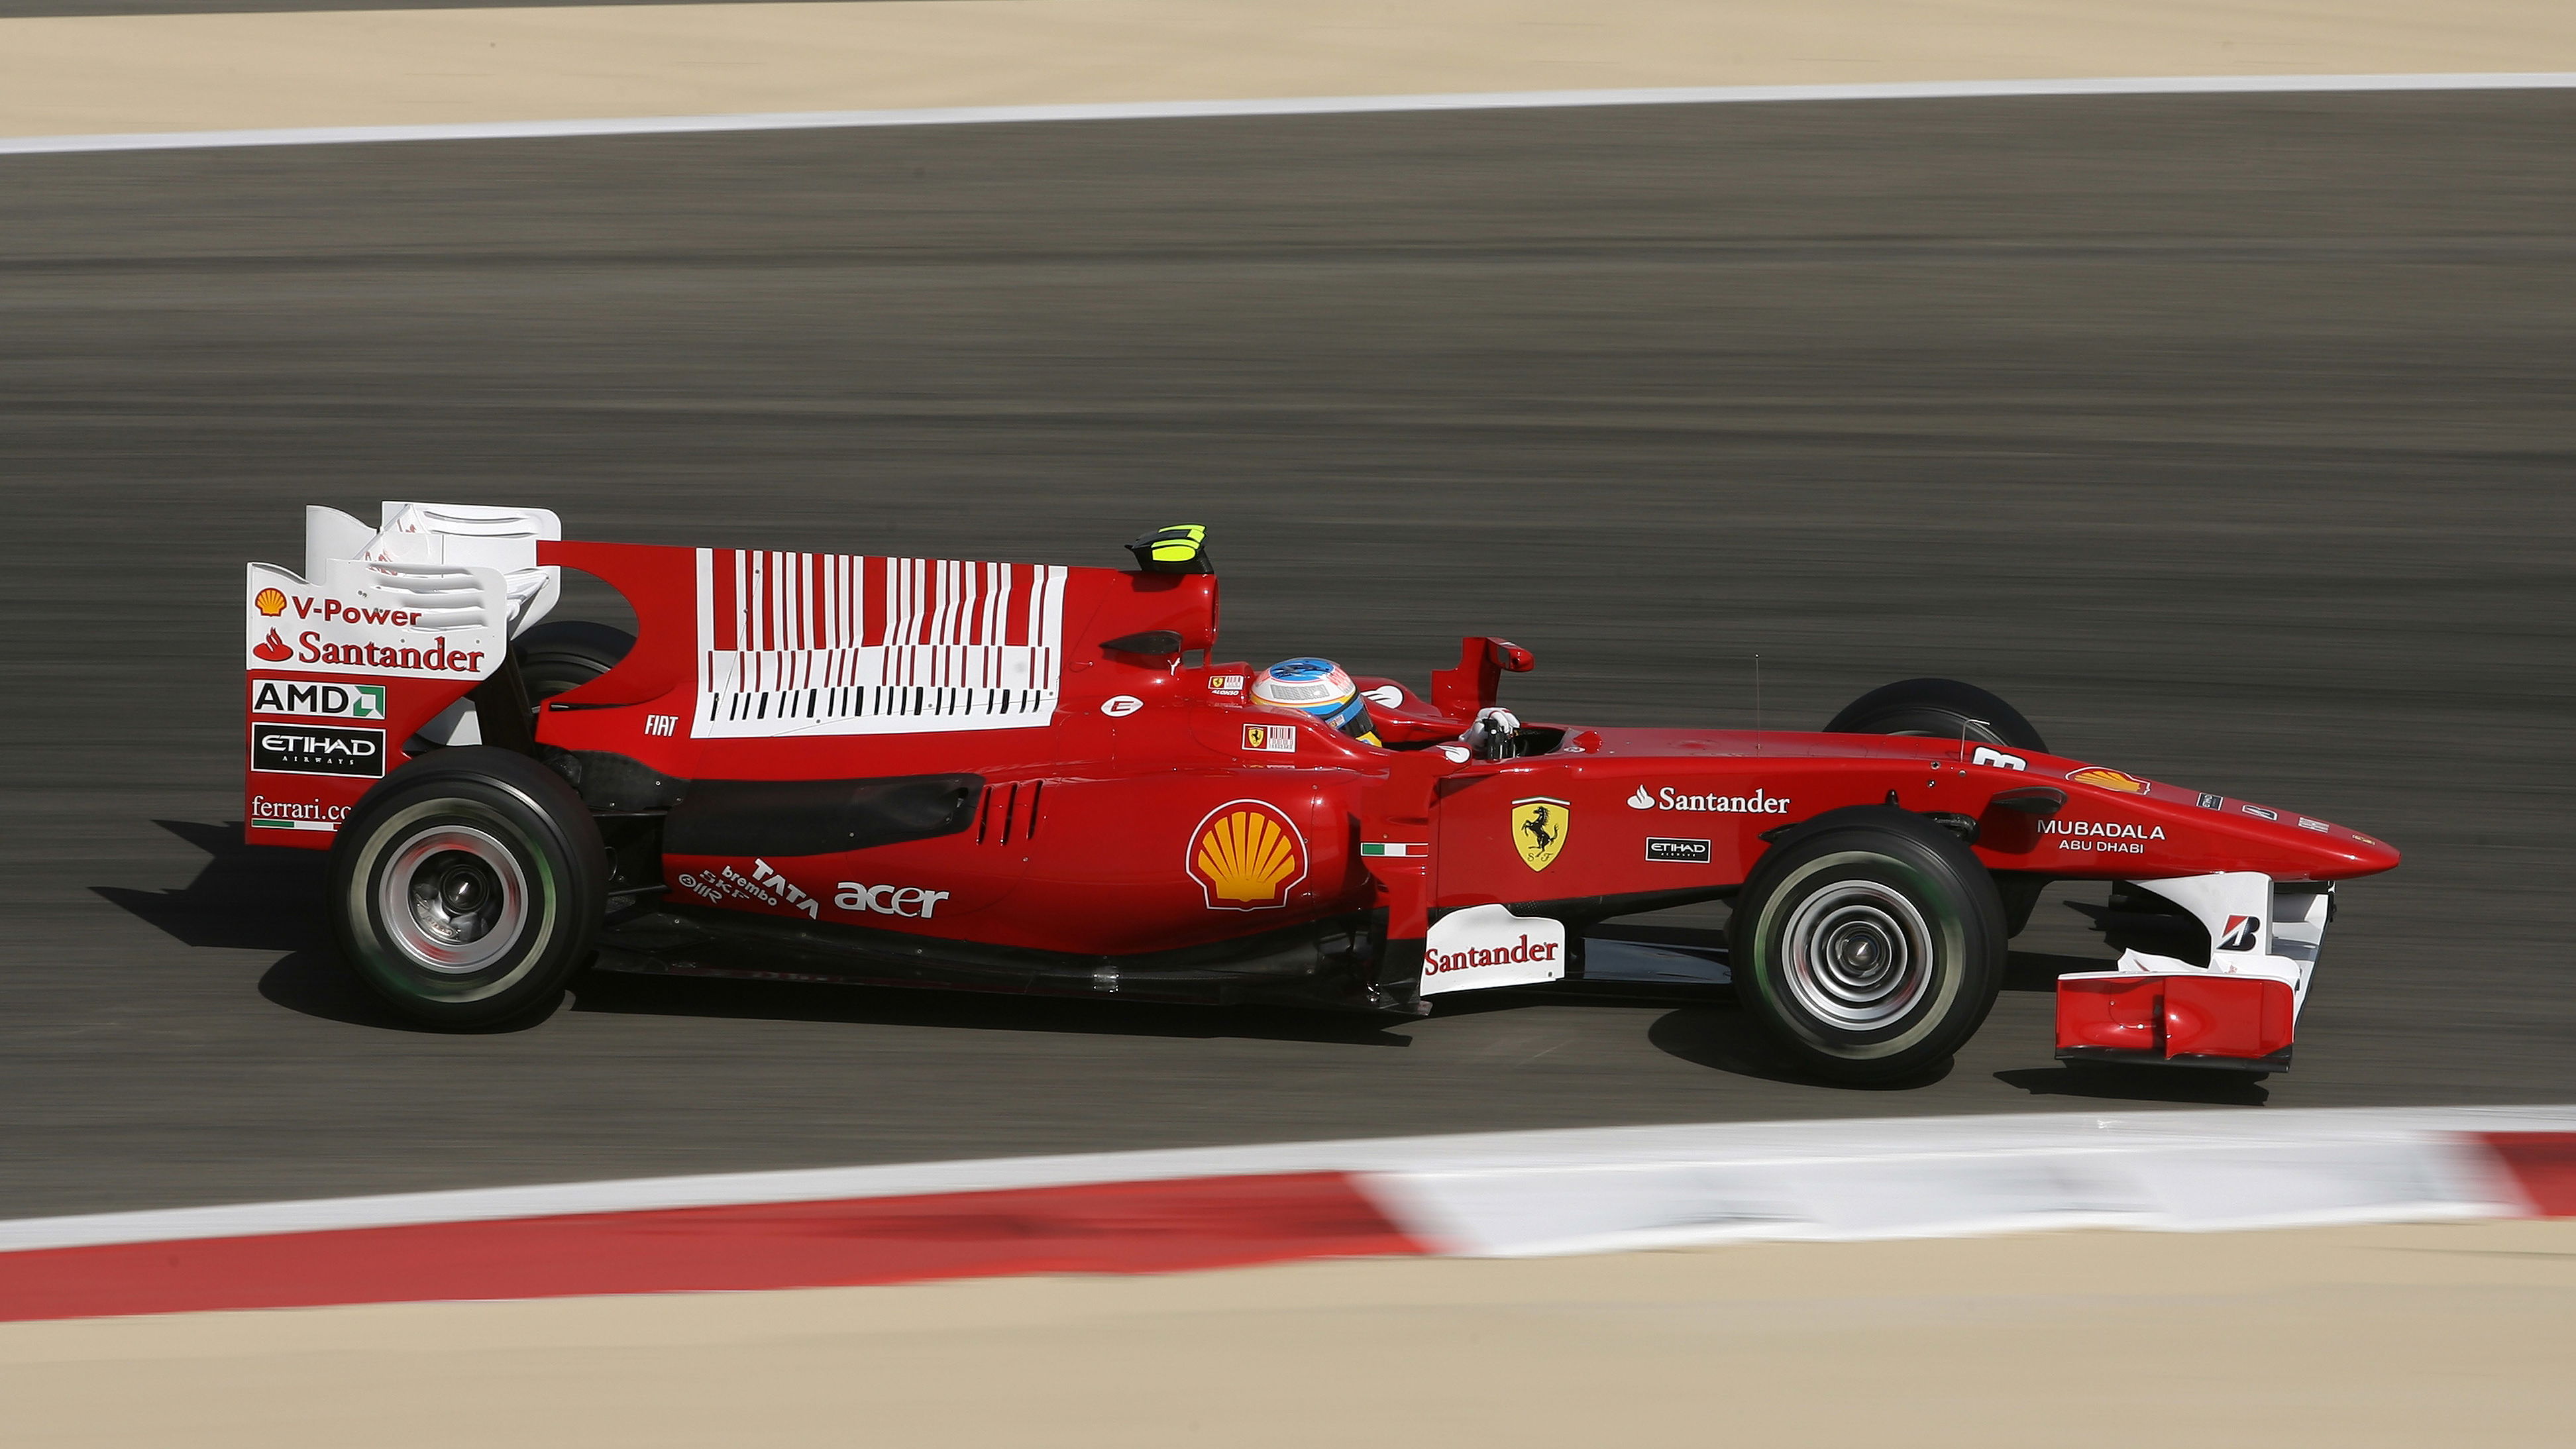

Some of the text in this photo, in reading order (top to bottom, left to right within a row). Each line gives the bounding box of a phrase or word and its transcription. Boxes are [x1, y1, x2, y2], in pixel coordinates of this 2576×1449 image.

[291, 595, 422, 626] V-Power
[298, 630, 485, 672] Santander
[254, 682, 349, 714] AMD
[645, 714, 679, 737] FIAT
[262, 734, 376, 756] ETIHAD
[282, 755, 354, 765] AIRWAYS
[1658, 786, 1791, 814] Santander
[2037, 819, 2167, 841] MUBADALA
[1650, 842, 1706, 853] ETIHAD
[2059, 839, 2144, 854] ABU DHABI
[722, 865, 778, 906] brembo
[752, 858, 820, 920] TATA
[834, 882, 950, 919] acer
[1424, 934, 1559, 976] Santander
